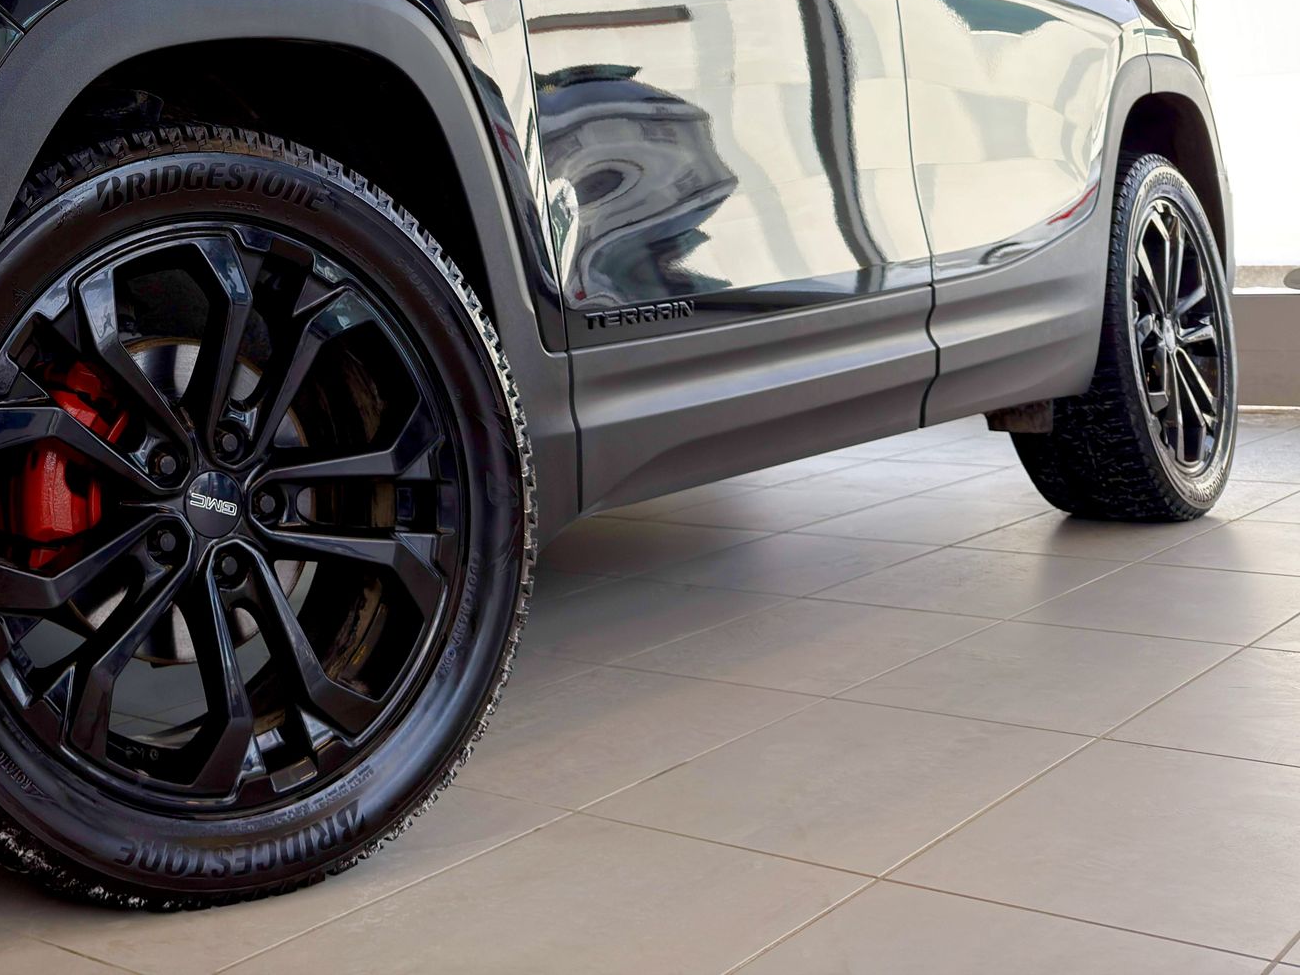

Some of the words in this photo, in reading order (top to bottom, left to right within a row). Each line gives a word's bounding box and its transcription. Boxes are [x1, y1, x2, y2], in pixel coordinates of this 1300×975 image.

[96, 161, 329, 217] BRIDGESTONE
[584, 300, 695, 330] TERRAIN
[189, 492, 238, 517] GMC
[113, 798, 367, 877] BRIDGESTONE
